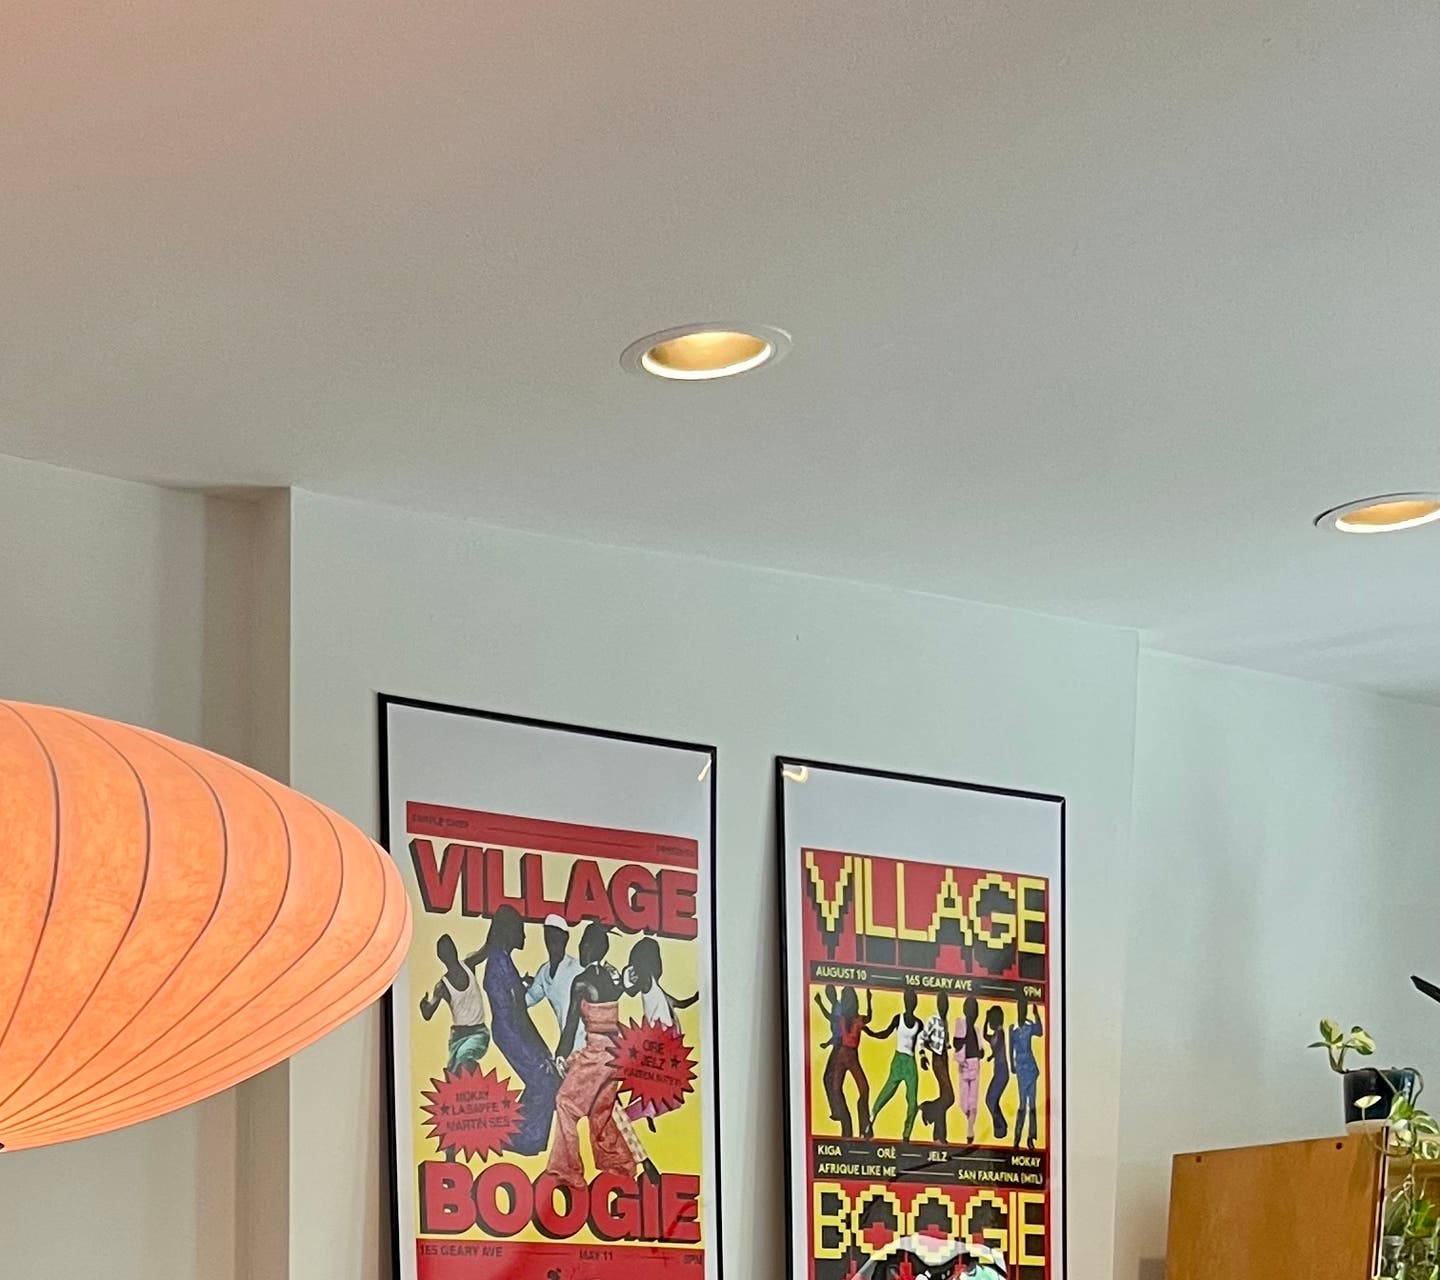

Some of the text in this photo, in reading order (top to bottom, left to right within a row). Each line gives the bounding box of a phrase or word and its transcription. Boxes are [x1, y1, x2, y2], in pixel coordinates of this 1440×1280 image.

[409, 838, 698, 940] VILLAGE
[805, 851, 1047, 958] VILLAGE
[815, 965, 855, 980] AUGUST
[856, 967, 867, 981] 10
[921, 976, 953, 989] GEARY
[955, 978, 973, 991] AVE
[1023, 987, 1042, 998] 9PM
[817, 1144, 842, 1157] KIGA
[926, 1150, 948, 1163] JELZ
[1011, 1156, 1041, 1168] MOKAY
[818, 1163, 860, 1176] AFRIQUE
[861, 1164, 882, 1176] LIKE
[882, 1165, 897, 1177] ME
[958, 1169, 977, 1181] SAN
[418, 1160, 701, 1243] BOOGIE
[813, 1182, 1046, 1268] BOOGIE
[440, 1245, 479, 1258] GEARY
